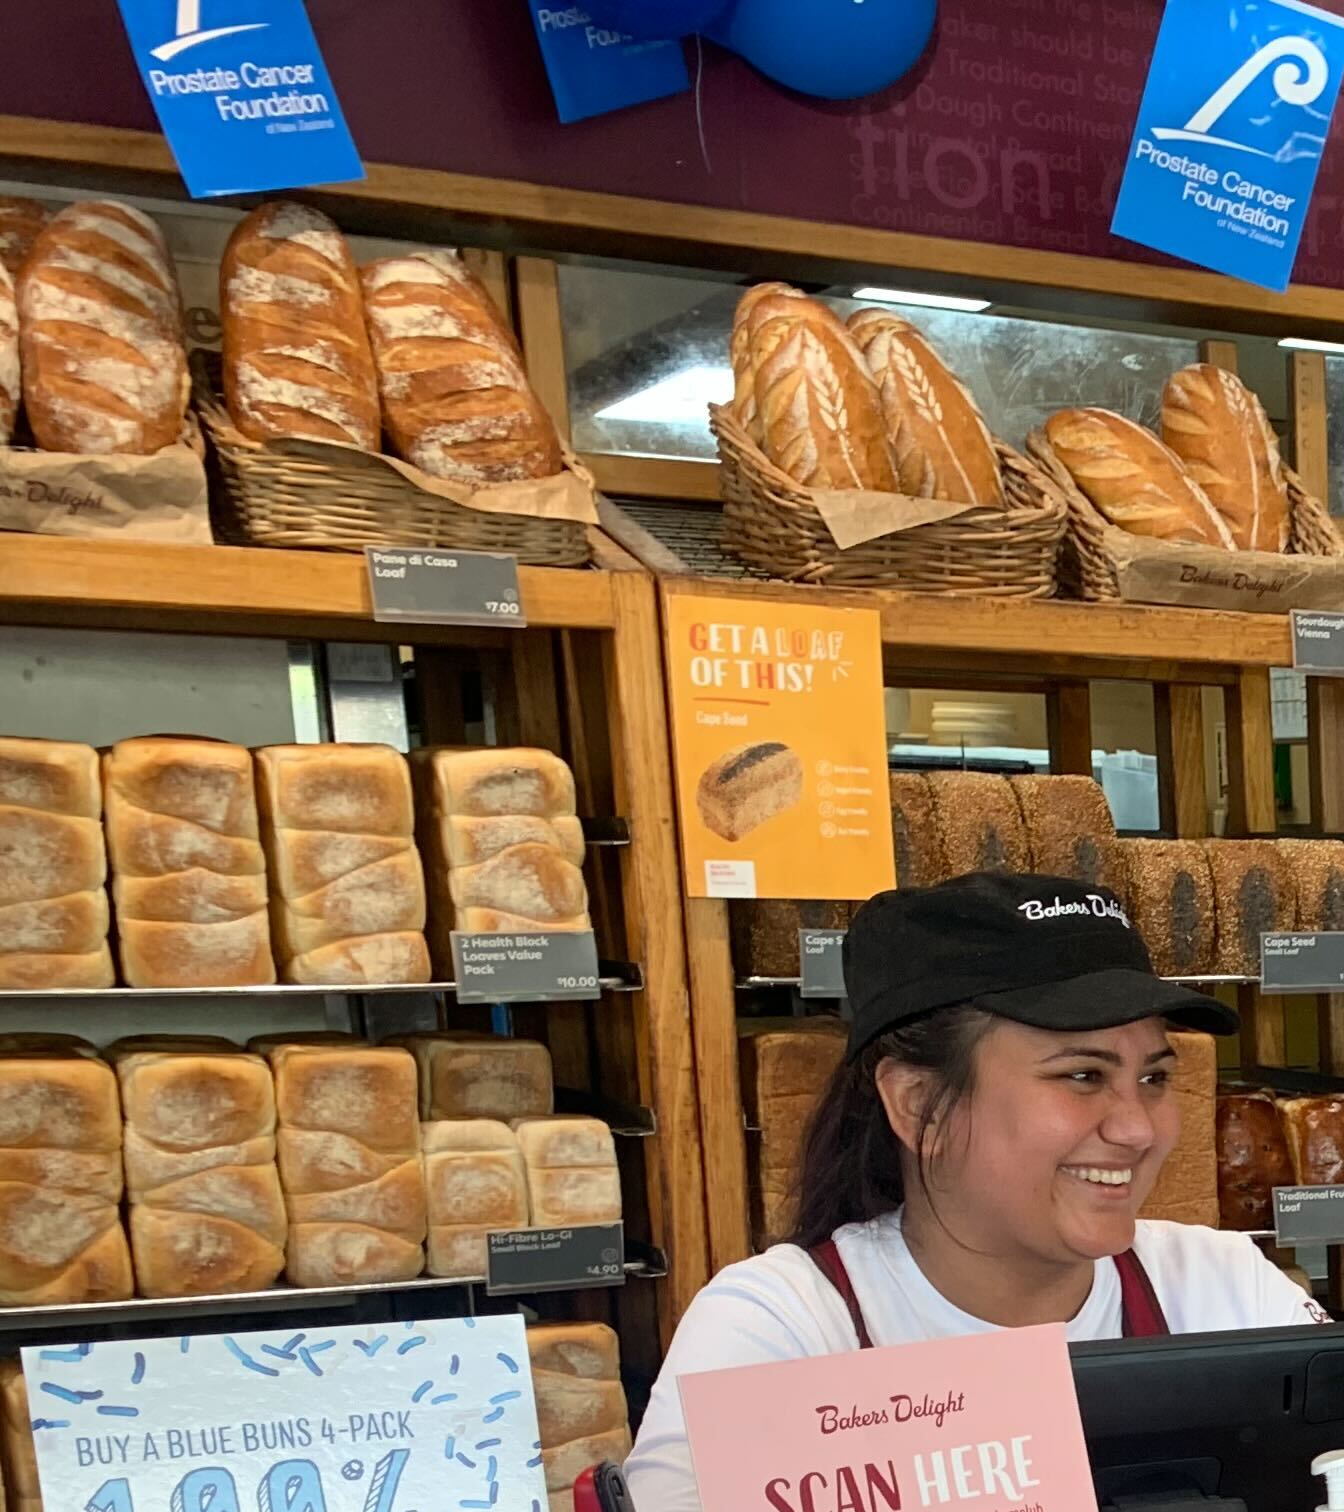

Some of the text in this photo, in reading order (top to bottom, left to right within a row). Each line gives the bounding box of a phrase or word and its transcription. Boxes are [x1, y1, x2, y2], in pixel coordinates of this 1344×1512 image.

[150, 62, 314, 95] Prostate Cancer
[215, 90, 328, 121] Foundation
[1136, 139, 1296, 212] Prostate Cancer
[1182, 181, 1288, 236] Foundation
[372, 552, 458, 568] Pane Casa
[375, 567, 406, 578] Loaf
[485, 602, 519, 614] $7.00
[1296, 628, 1330, 638] Vienna
[689, 623, 843, 660] GET A LOAF
[690, 656, 814, 692] OF THIS!
[1018, 896, 1090, 920] Bakers
[472, 936, 549, 948] Health Block
[1264, 936, 1316, 948] Cape Seed
[463, 950, 543, 962] Loaves Value
[464, 964, 495, 976] Pack
[557, 976, 596, 988] $10.00
[1278, 1190, 1328, 1201] Traditional
[1280, 1202, 1301, 1212] Loaf
[816, 1390, 966, 1434] Bakers Delight
[75, 1410, 416, 1466] BUY A BLUE BUNS 4-PACK
[913, 1435, 1040, 1508] HERE
